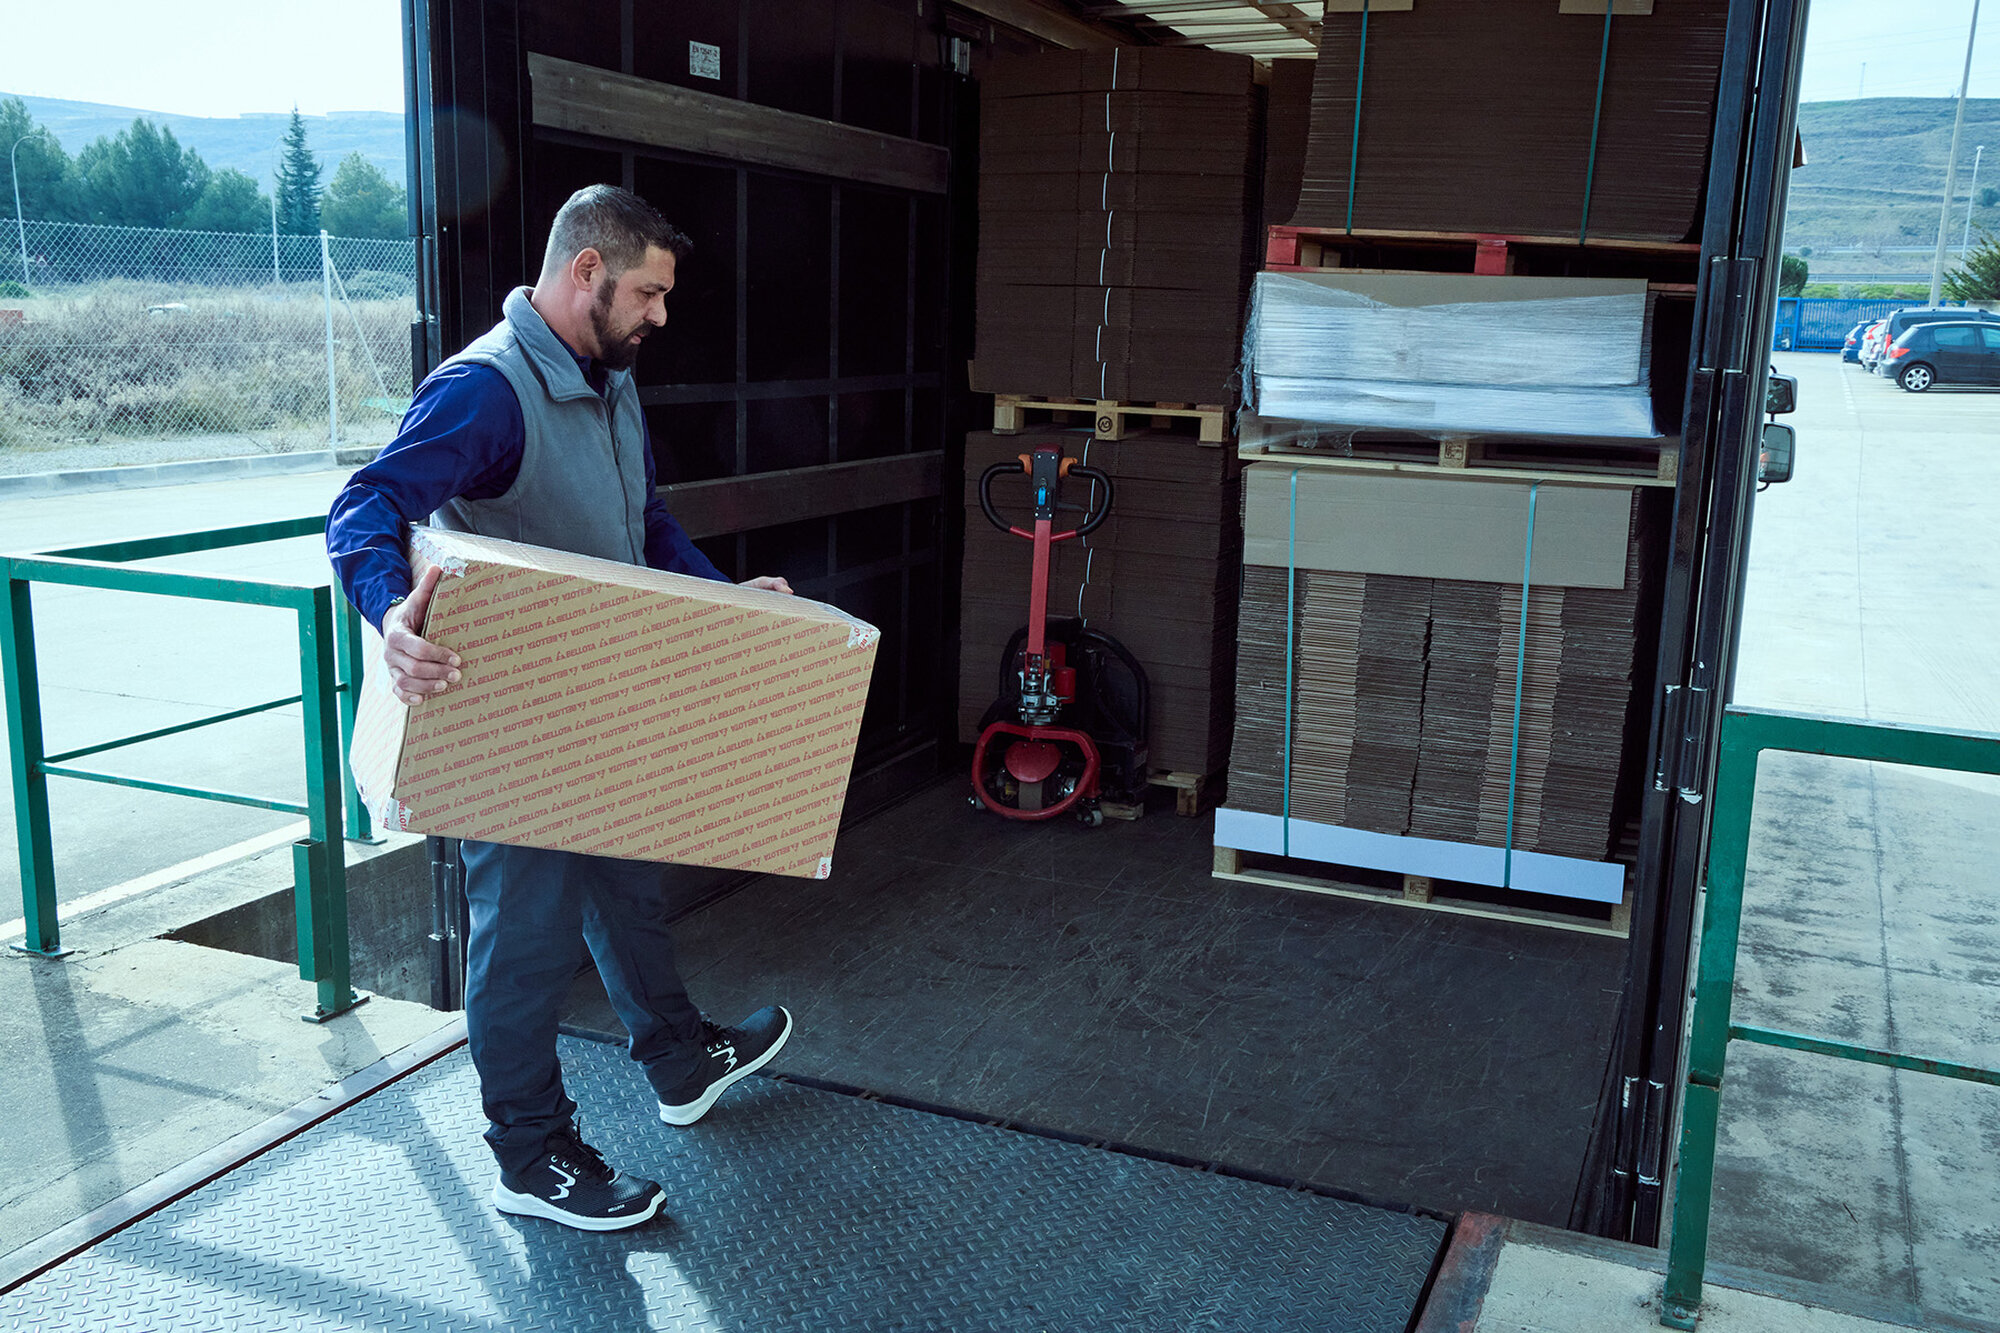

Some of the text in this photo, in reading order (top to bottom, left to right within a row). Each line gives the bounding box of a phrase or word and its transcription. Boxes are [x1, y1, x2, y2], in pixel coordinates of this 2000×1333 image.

[463, 575, 496, 591] BELLOTA
[456, 598, 489, 614] BELLOTA
[501, 585, 533, 601] BELLOTA
[428, 585, 593, 640] BELLOTA BELLOTA BELLOTA BELLOTA
[466, 594, 629, 650] BELLOTA BELLOTA BELLOTA BELLOTA
[483, 595, 686, 663] BELLOTA BELLOTA BELLOTA BELLOTA BELLOTA
[705, 616, 735, 631] BELLOTA
[476, 669, 509, 685] BELLOTA
[521, 655, 553, 672] BELLOTA
[564, 642, 596, 658] BELLOTA
[607, 629, 638, 645] BELLOTA
[649, 616, 680, 632] BELLOTA
[690, 604, 720, 619] BELLOTA
[664, 629, 695, 644] BELLOTA
[623, 642, 654, 657] BELLOTA
[581, 655, 612, 670] BELLOTA
[800, 657, 829, 672] BELLOTA
[442, 718, 475, 734] BELLOTA
[486, 704, 519, 720] BELLOTA
[531, 690, 563, 706] BELLOTA
[574, 677, 605, 693] BELLOTA
[617, 664, 647, 679] BELLOTA
[658, 651, 689, 666] BELLOTA
[699, 638, 729, 653] BELLOTA
[739, 625, 769, 640] BELLOTA
[537, 668, 569, 684] BELLOTA
[761, 670, 790, 685] BELLOTA
[413, 625, 821, 762] BELLOTA BELLOTA BELLOTA BELLOTA BELLOTA BELLOTA BELLOTA BELLOTA BELLOTA BELLOTA
[493, 681, 526, 698] BELLOTA
[722, 683, 751, 698] BELLOTA
[808, 690, 836, 705] BELLOTA
[448, 695, 482, 712] BELLOTA
[682, 696, 712, 712] BELLOTA
[769, 703, 798, 718] BELLOTA
[407, 767, 440, 784] BELLOTA
[452, 753, 485, 770] BELLOTA
[497, 739, 529, 755] BELLOTA
[540, 725, 572, 741] BELLOTA
[583, 711, 615, 727] BELLOTA
[626, 698, 656, 713] BELLOTA
[667, 684, 697, 700] BELLOTA
[708, 671, 737, 686] BELLOTA
[748, 658, 777, 673] BELLOTA
[787, 646, 815, 660] BELLOTA
[641, 710, 671, 725] BELLOTA
[599, 723, 630, 739] BELLOTA
[730, 716, 759, 731] BELLOTA
[816, 722, 844, 737] BELLOTA
[418, 666, 861, 820] BELLOTA BELLOTA BELLOTA BELLOTA BELLOTA BELLOTA BELLOTA BELLOTA BELLOTA BELLOTA BELLOTA
[556, 737, 588, 753] BELLOTA
[690, 730, 719, 745] BELLOTA
[777, 735, 806, 750] BELLOTA
[513, 751, 545, 767] BELLOTA
[649, 743, 679, 759] BELLOTA
[738, 749, 767, 764] BELLOTA
[608, 757, 638, 773] BELLOTA
[823, 754, 851, 769] BELLOTA
[469, 765, 502, 782] BELLOTA
[473, 822, 506, 839] BELLOTA
[517, 807, 549, 824] BELLOTA
[560, 793, 591, 809] BELLOTA
[602, 779, 633, 795] BELLOTA
[644, 764, 674, 780] BELLOTA
[684, 751, 714, 766] BELLOTA
[724, 737, 754, 752] BELLOTA
[764, 724, 793, 739] BELLOTA
[802, 711, 831, 726] BELLOTA
[699, 762, 728, 778] BELLOTA
[785, 768, 813, 783] BELLOTA
[565, 771, 597, 787] BELLOTA
[658, 776, 688, 792] BELLOTA
[424, 780, 457, 797] BELLOTA
[522, 785, 554, 802] BELLOTA
[569, 743, 838, 843] BELLOTA BELLOTA BELLOTA BELLOTA BELLOTA BELLOTA BELLOTA
[746, 781, 775, 796] BELLOTA
[617, 790, 648, 806] BELLOTA
[706, 795, 736, 810] BELLOTA
[478, 800, 511, 816] BELLOTA
[575, 804, 606, 821] BELLOTA
[661, 830, 691, 846] BELLOTA
[701, 816, 731, 831] BELLOTA
[741, 802, 770, 817] BELLOTA
[780, 788, 808, 803] BELLOTA
[818, 775, 846, 789] BELLOTA
[434, 815, 467, 832] BELLOTA
[666, 809, 696, 825] BELLOTA
[532, 819, 564, 835] BELLOTA
[625, 823, 656, 839] BELLOTA
[675, 799, 821, 857] BELLOTA BELLOTA BELLOTA BELLOTA
[710, 848, 739, 864] BELLOTA
[749, 834, 778, 849] BELLOTA
[788, 820, 816, 835] BELLOTA
[800, 831, 828, 846] BELLOTA
[762, 845, 790, 860] BELLOTA
